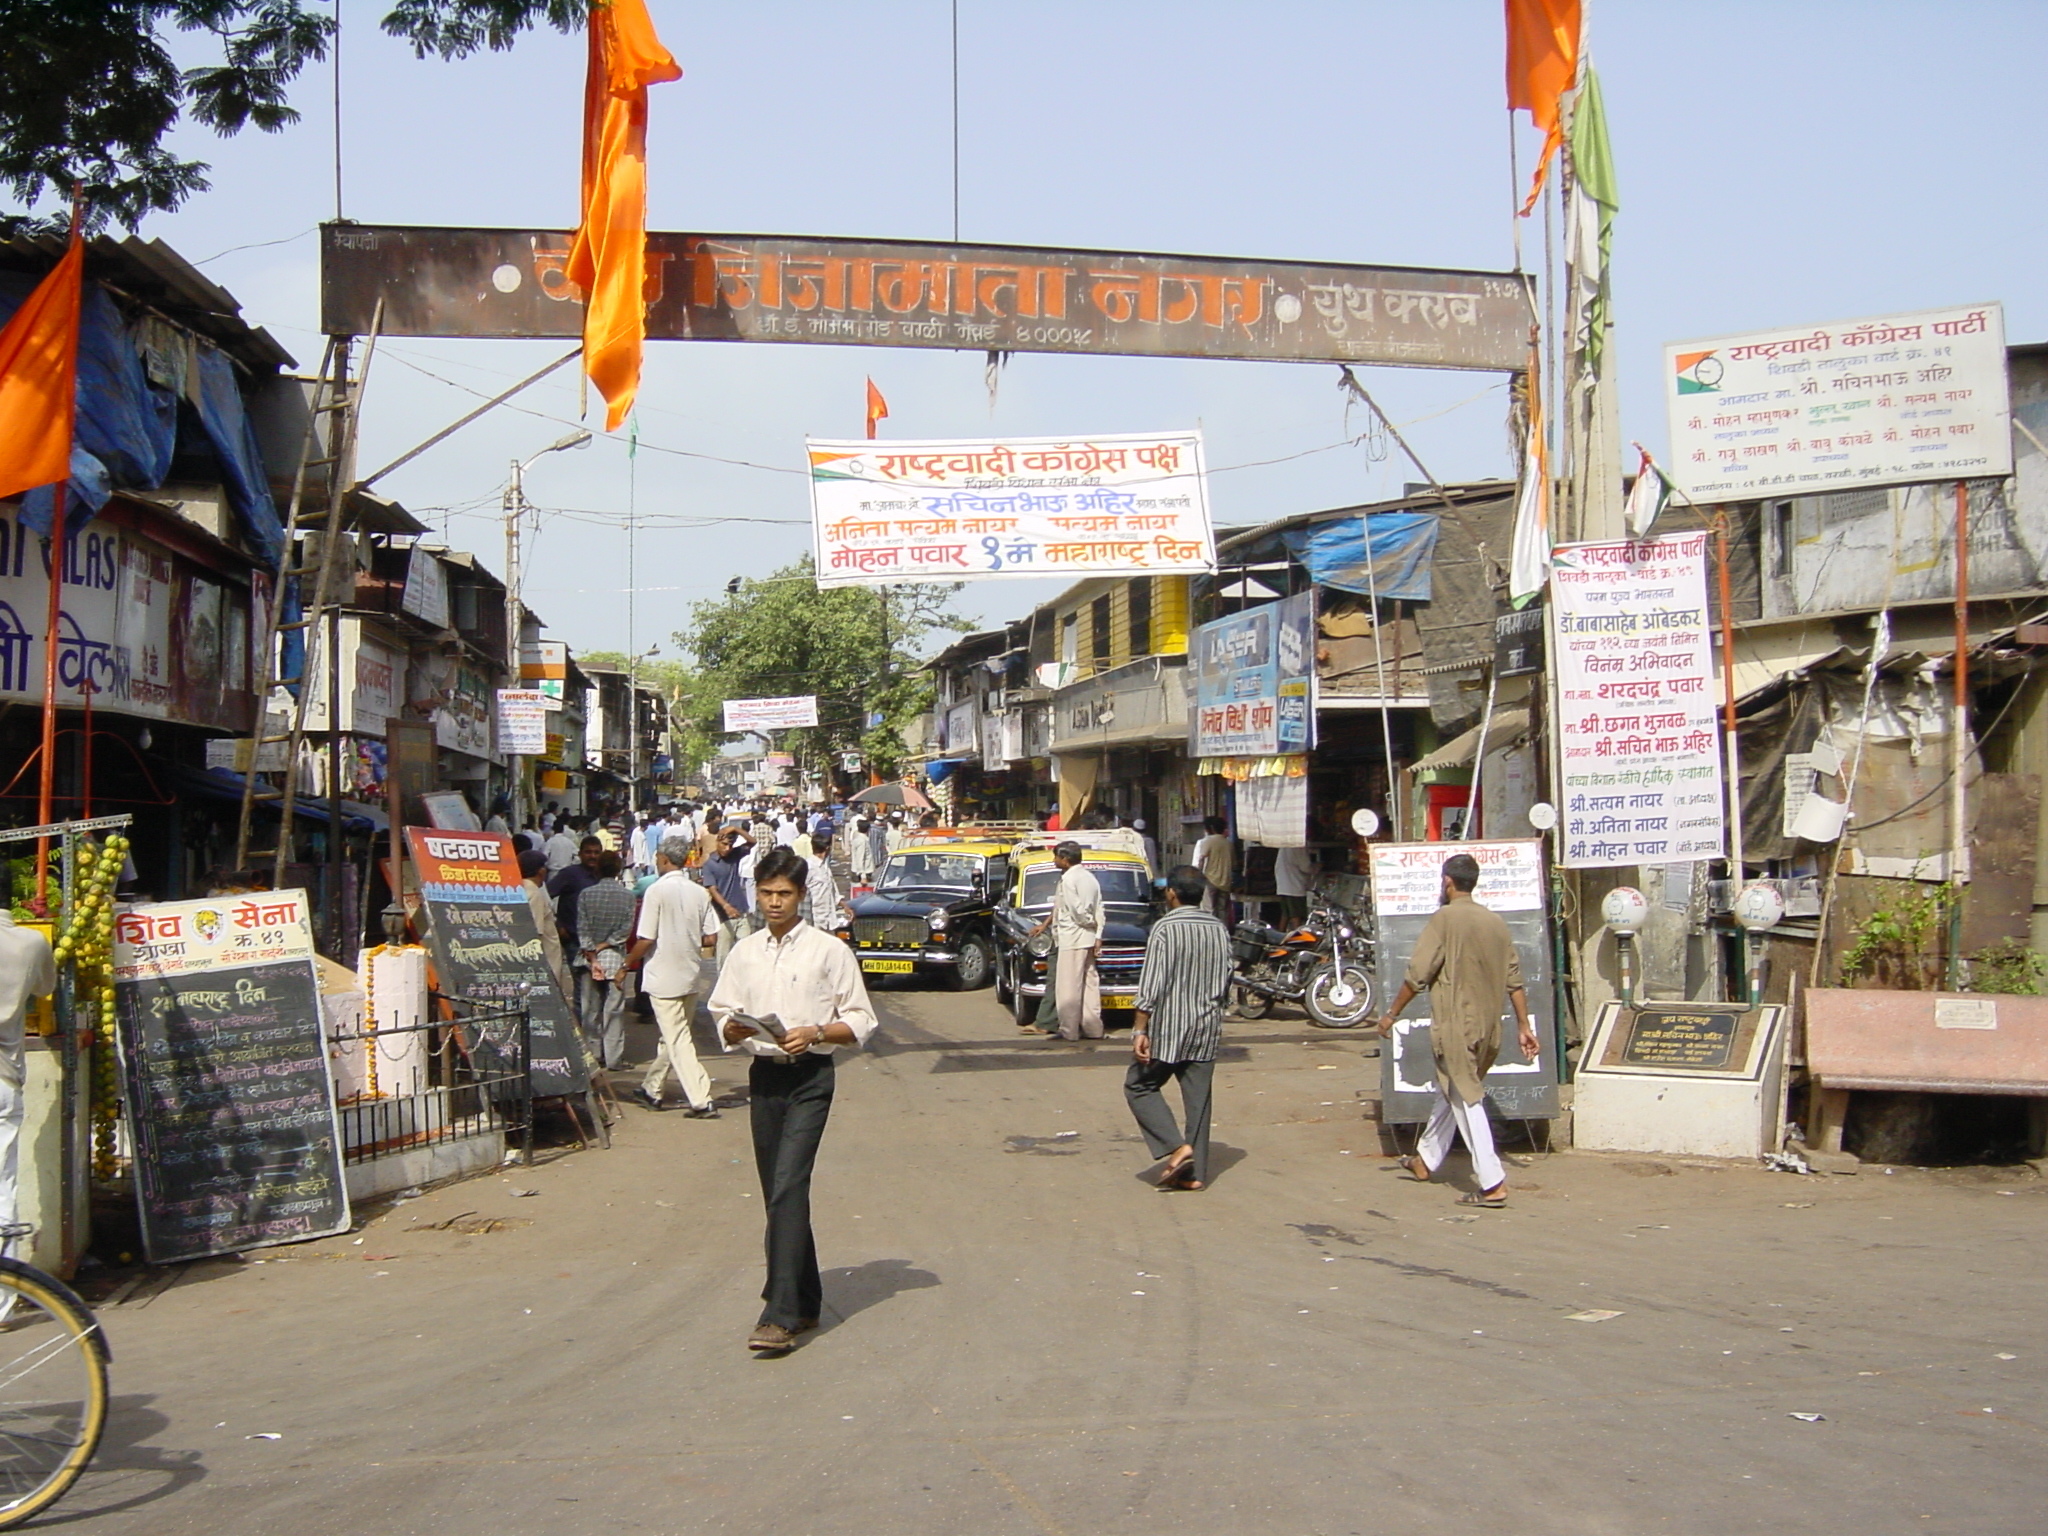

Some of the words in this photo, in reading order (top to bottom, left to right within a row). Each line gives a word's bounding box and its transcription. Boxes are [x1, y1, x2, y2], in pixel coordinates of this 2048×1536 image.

[684, 235, 1076, 322] जिजामाता
[1089, 268, 1273, 341] नगर
[1381, 287, 1483, 331] क्लब
[1728, 330, 1832, 361] राष्ट्रवादी
[1931, 310, 1987, 336] पार्टी
[1767, 356, 1811, 376] शिवडी
[1718, 392, 1770, 406] आमदार
[1799, 377, 1827, 395] श्री.
[1916, 362, 1953, 383] अहिर
[1688, 416, 1708, 430] श्री.
[1712, 413, 1741, 427] मोहन
[1877, 393, 1898, 408] श्री.
[1944, 388, 1973, 401] नायर
[1692, 448, 1712, 463] श्री.
[1787, 437, 1806, 452] श्री.
[1882, 427, 1903, 442] श्री.
[1910, 424, 1941, 439] मोहन
[1948, 423, 1975, 437] पवार
[875, 445, 1017, 481] राष्ट्रवादी
[1134, 444, 1181, 473] पक्ष
[1073, 487, 1140, 514] अहिर
[824, 515, 891, 543] अनिता
[893, 518, 958, 536] सत्यम
[962, 517, 1019, 534] नायर
[1047, 515, 1120, 532] सत्यम
[1124, 513, 1180, 531] नायर
[831, 543, 904, 573] मोहन
[907, 544, 970, 568] पवार
[980, 535, 1003, 570] १
[1004, 537, 1038, 564] मे
[1043, 541, 1151, 567] महाराष्ट्र
[1152, 534, 1203, 564] दिन
[1581, 541, 1636, 567] राष्ट्रवादी
[1642, 607, 1701, 629] आंबेडकर
[1628, 649, 1694, 671] अभिवादन
[1597, 676, 1662, 699] शरदचंद्र
[1667, 676, 1704, 695] पवार
[1643, 712, 1686, 735] भुजबळ
[1655, 735, 1679, 753] भाऊ
[1682, 729, 1713, 754] अहिर
[1629, 793, 1664, 809] नायर
[1635, 816, 1669, 832] नायर
[424, 836, 501, 861] षटकार
[1633, 840, 1669, 856] पवार
[116, 912, 182, 945] शिव
[231, 900, 298, 930] सेना
[132, 940, 186, 962] शाखा
[233, 932, 258, 948] क्र.
[235, 978, 268, 1007] दिन
